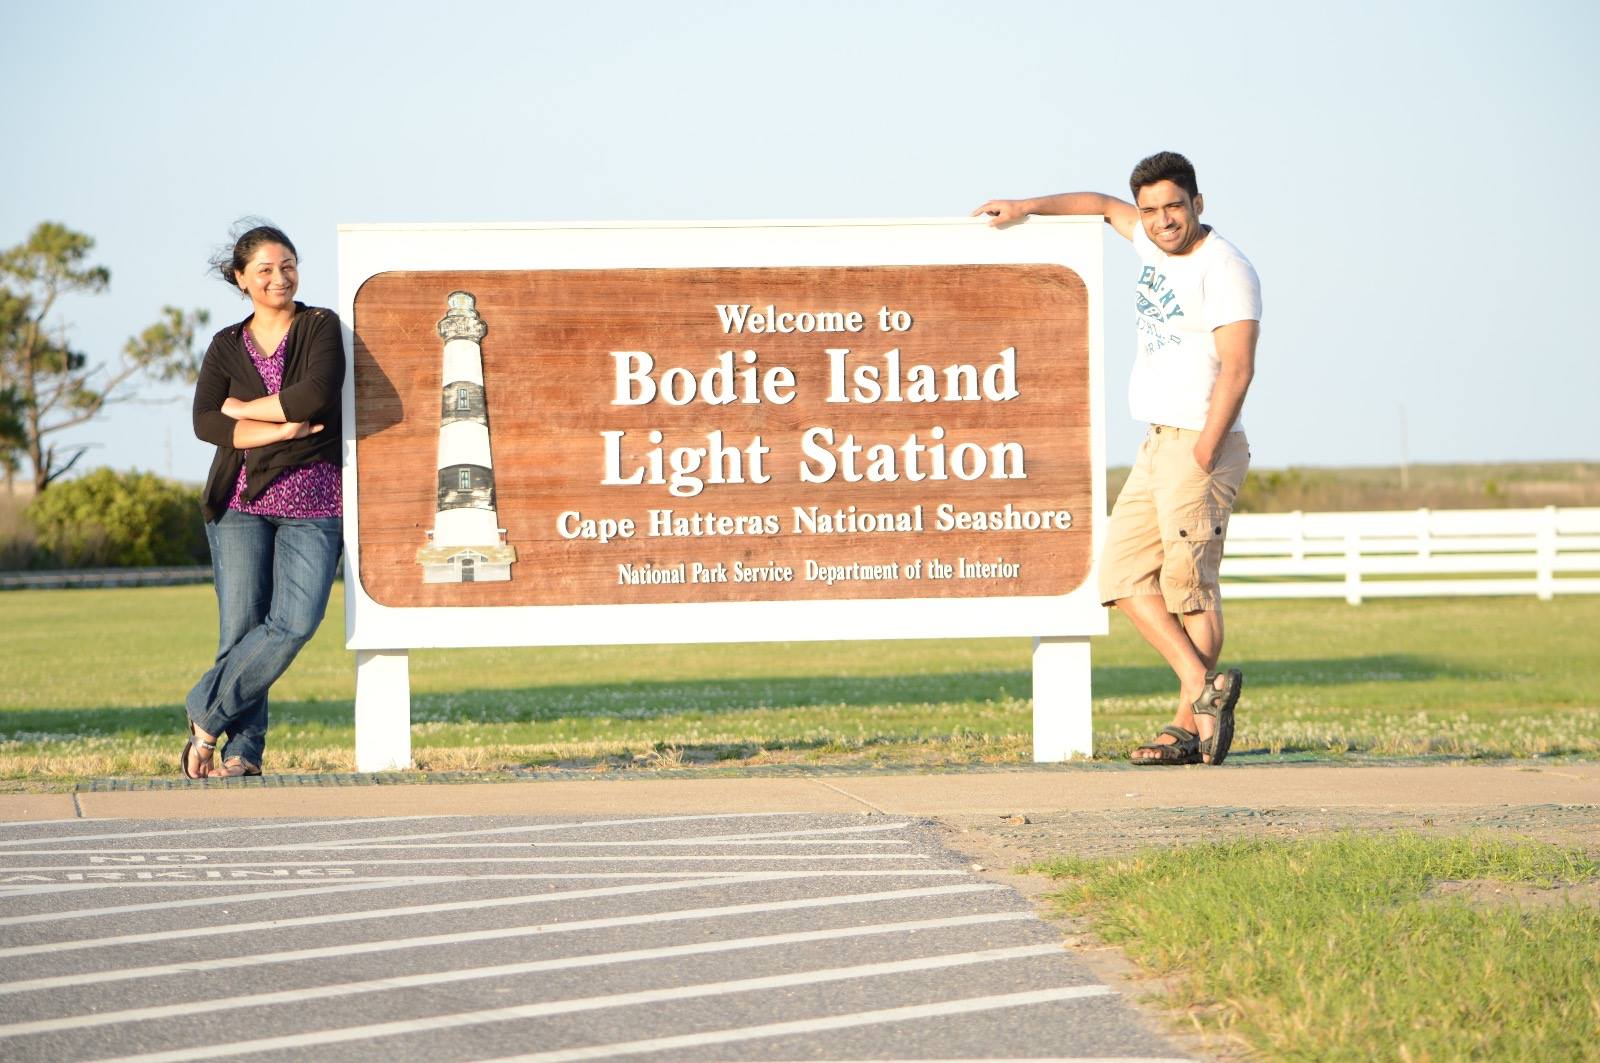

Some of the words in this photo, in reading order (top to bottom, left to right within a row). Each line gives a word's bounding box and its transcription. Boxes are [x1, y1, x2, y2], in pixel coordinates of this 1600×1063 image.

[715, 304, 863, 334] Welcome
[878, 306, 912, 332] to
[610, 349, 796, 406] Bodie
[825, 347, 1020, 403] Island
[600, 429, 771, 497] Light
[799, 426, 1027, 484] Station
[556, 511, 635, 544] Cape
[648, 509, 779, 537] Hatteras
[793, 505, 923, 534] National
[936, 503, 1072, 532] Seashore
[617, 562, 685, 585] National
[692, 562, 728, 583] Park
[733, 561, 793, 582] Service
[805, 559, 899, 585] Department
[904, 559, 922, 580] of
[928, 558, 953, 579] the
[959, 557, 1021, 579] Interior
[88, 854, 209, 863] NO
